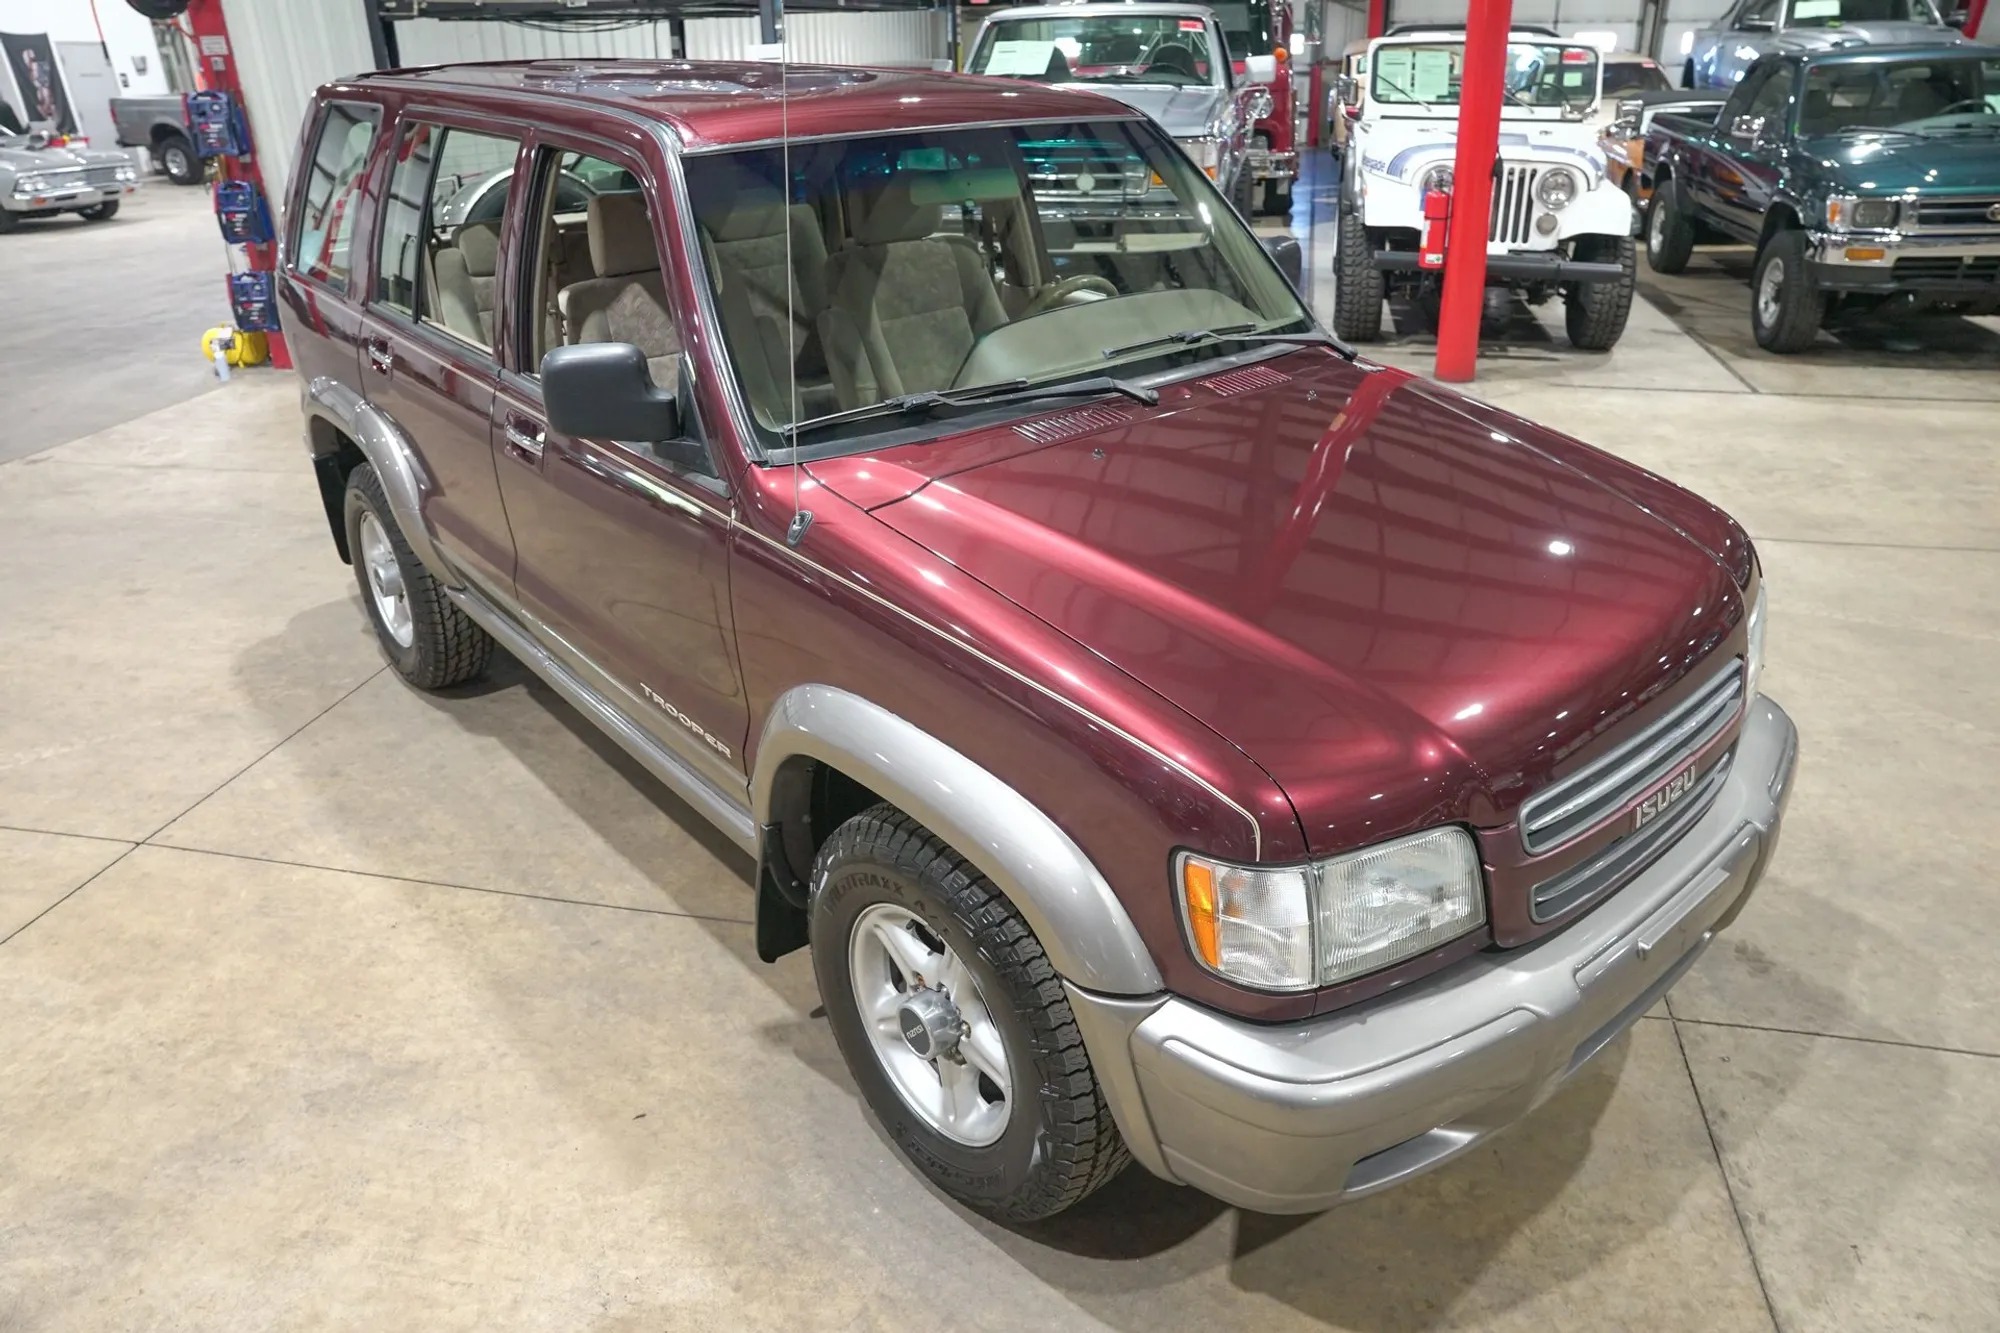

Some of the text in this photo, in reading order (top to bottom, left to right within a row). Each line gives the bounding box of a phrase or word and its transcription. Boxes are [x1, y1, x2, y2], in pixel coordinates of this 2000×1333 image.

[639, 682, 732, 759] TROOPER
[1636, 764, 1696, 829] ISUZU
[906, 1024, 925, 1040] ISUZU
